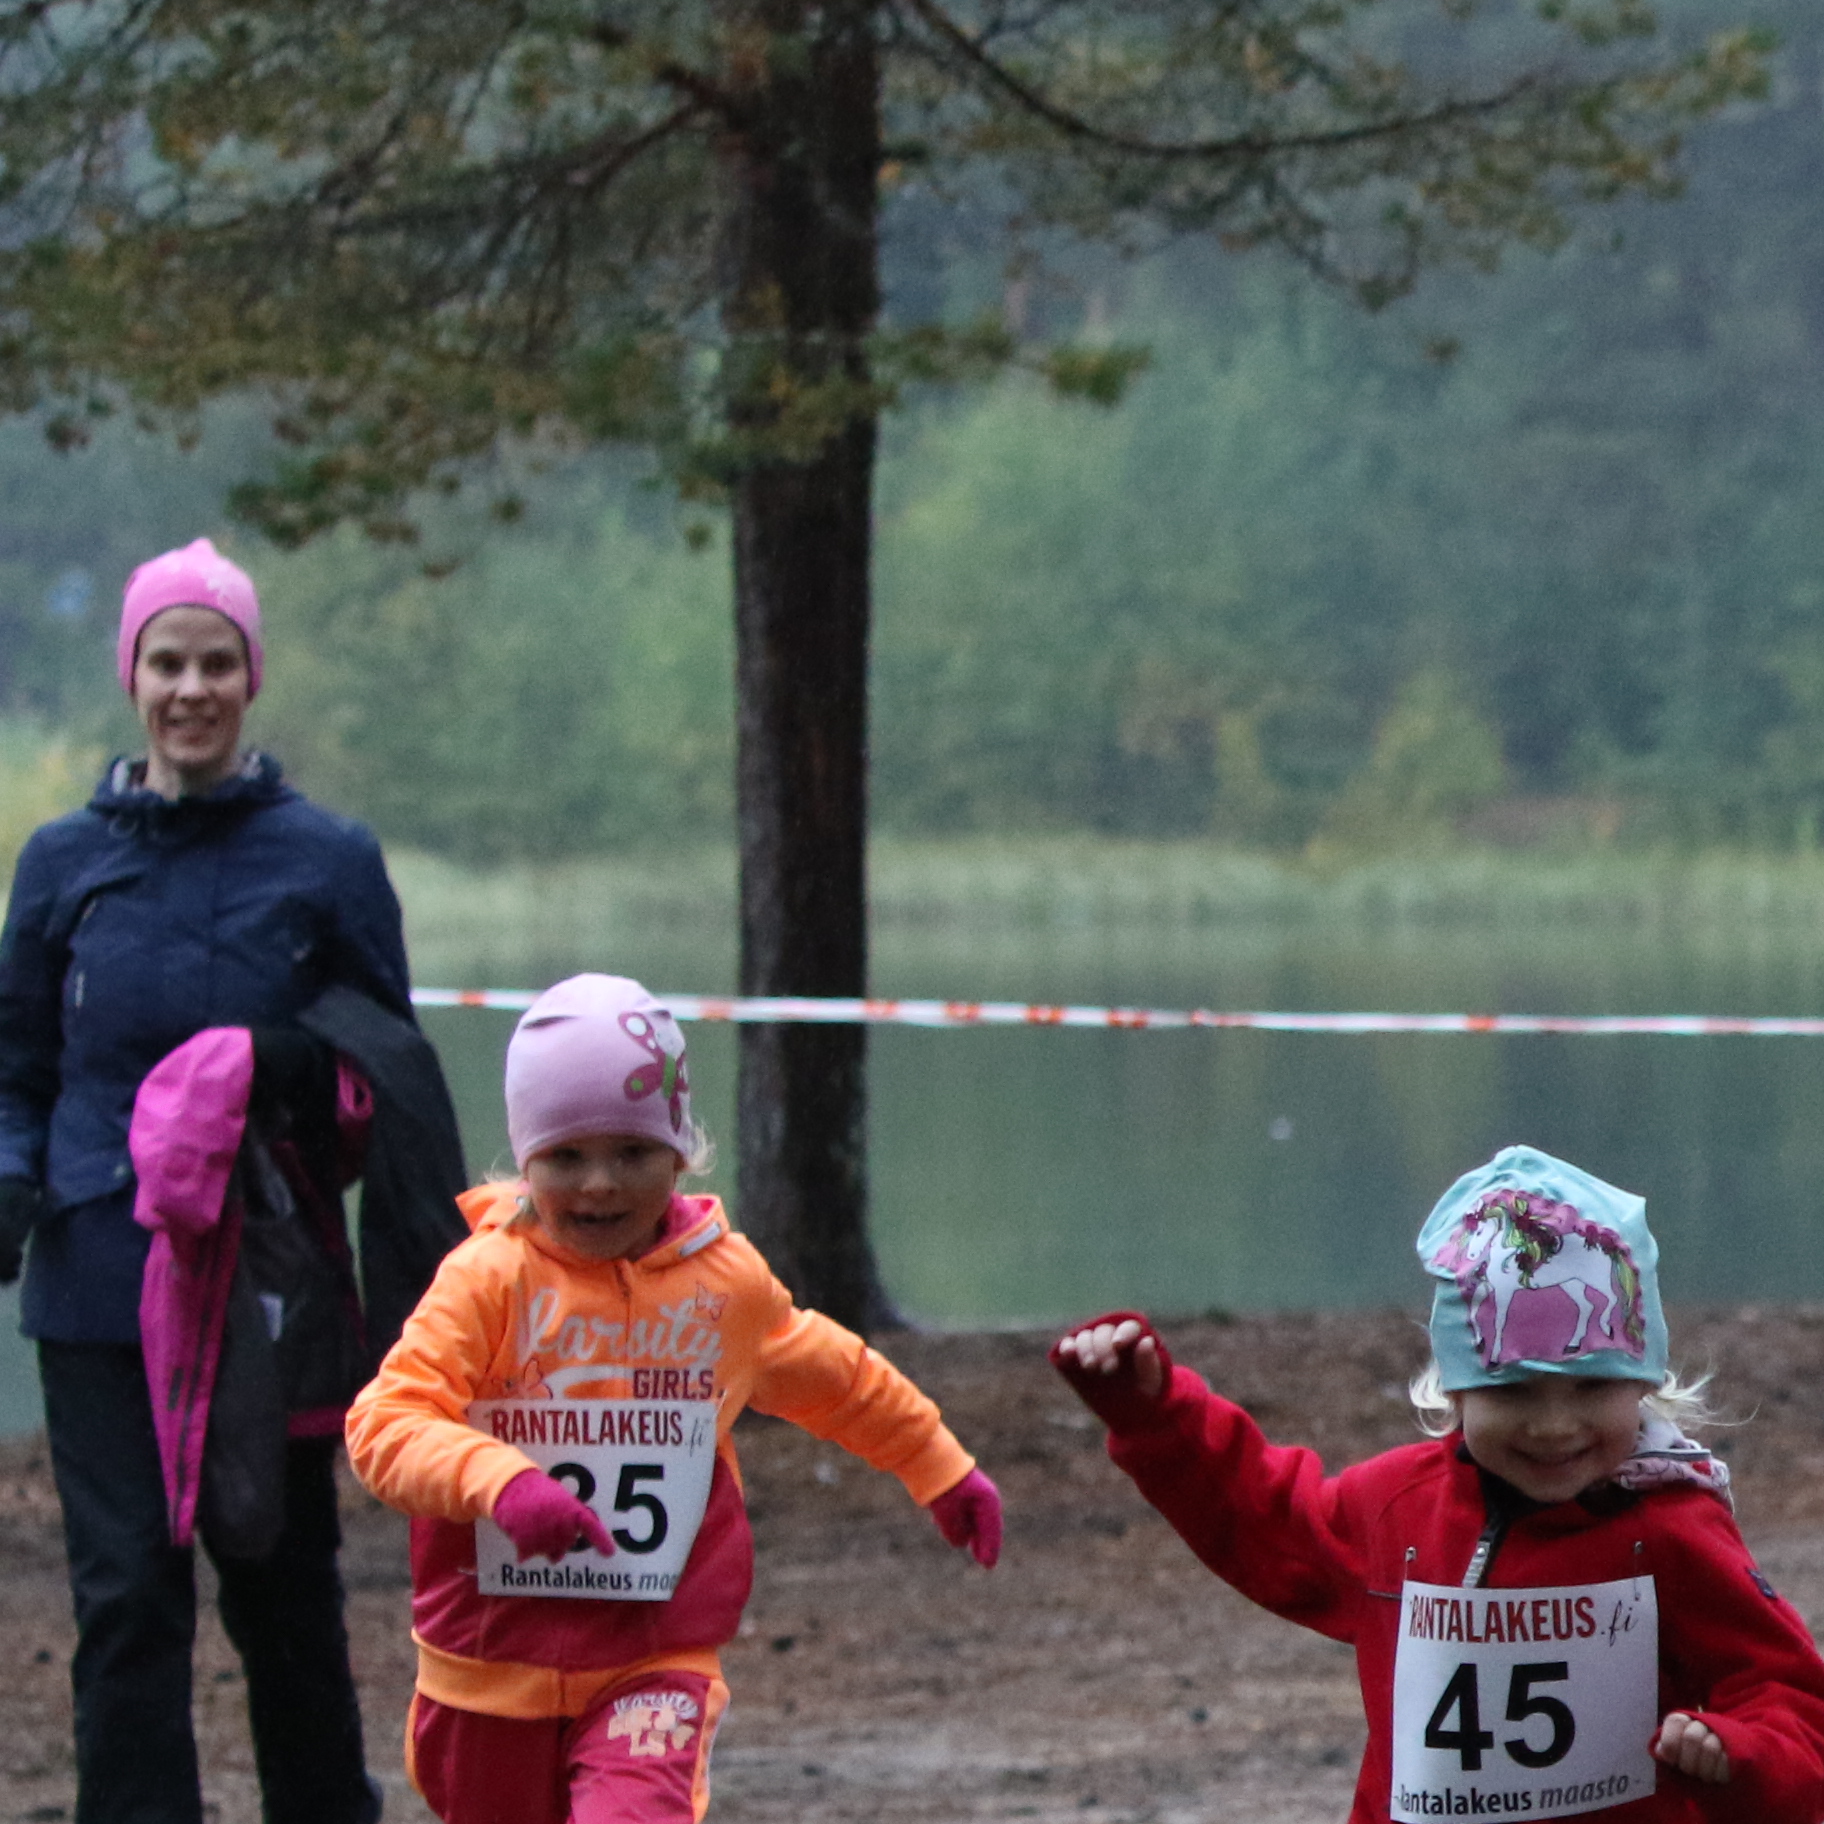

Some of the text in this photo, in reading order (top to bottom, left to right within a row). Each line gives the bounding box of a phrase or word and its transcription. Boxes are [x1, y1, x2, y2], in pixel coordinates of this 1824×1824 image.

[502, 1563, 632, 1591] Rantalakeus
[1424, 1661, 1575, 1771] 45
[1539, 1774, 1628, 1809] maasto
